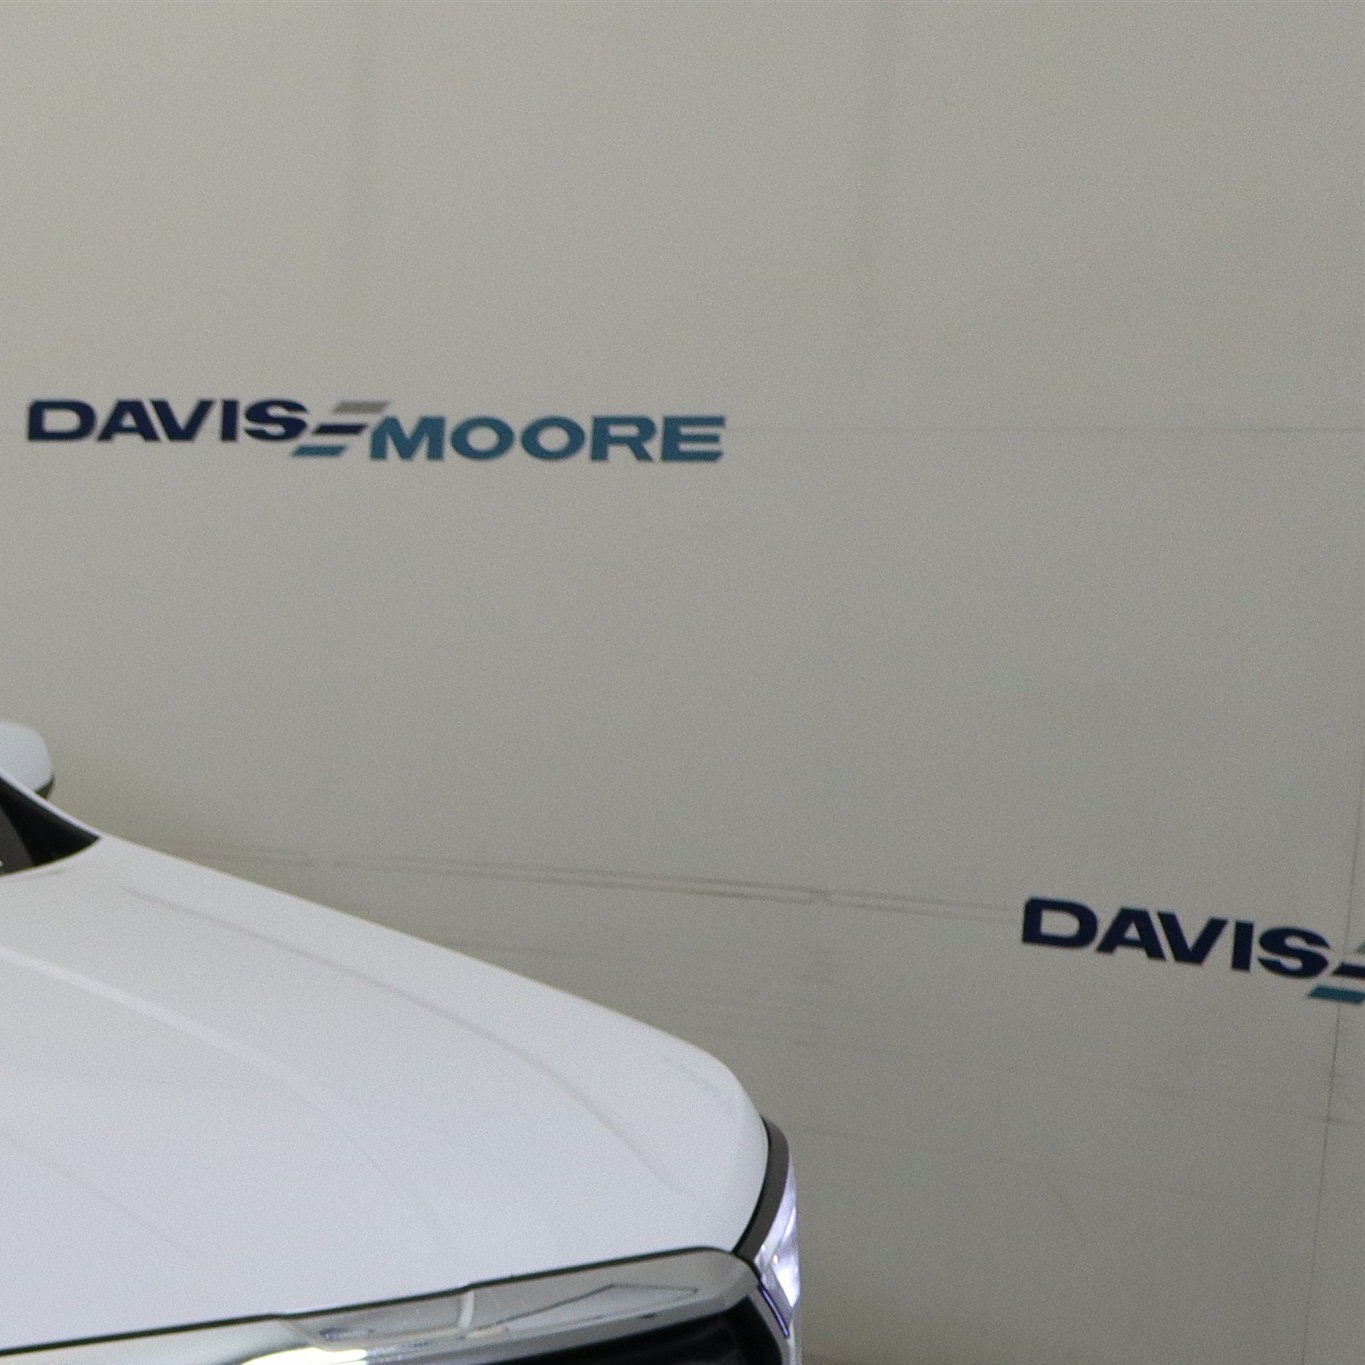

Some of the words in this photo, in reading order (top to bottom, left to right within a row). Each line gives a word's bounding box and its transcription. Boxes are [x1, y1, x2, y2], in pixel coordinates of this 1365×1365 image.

[26, 399, 309, 443] DAVIS
[369, 415, 727, 463] MOORE
[1021, 896, 1331, 981] DAVIS
